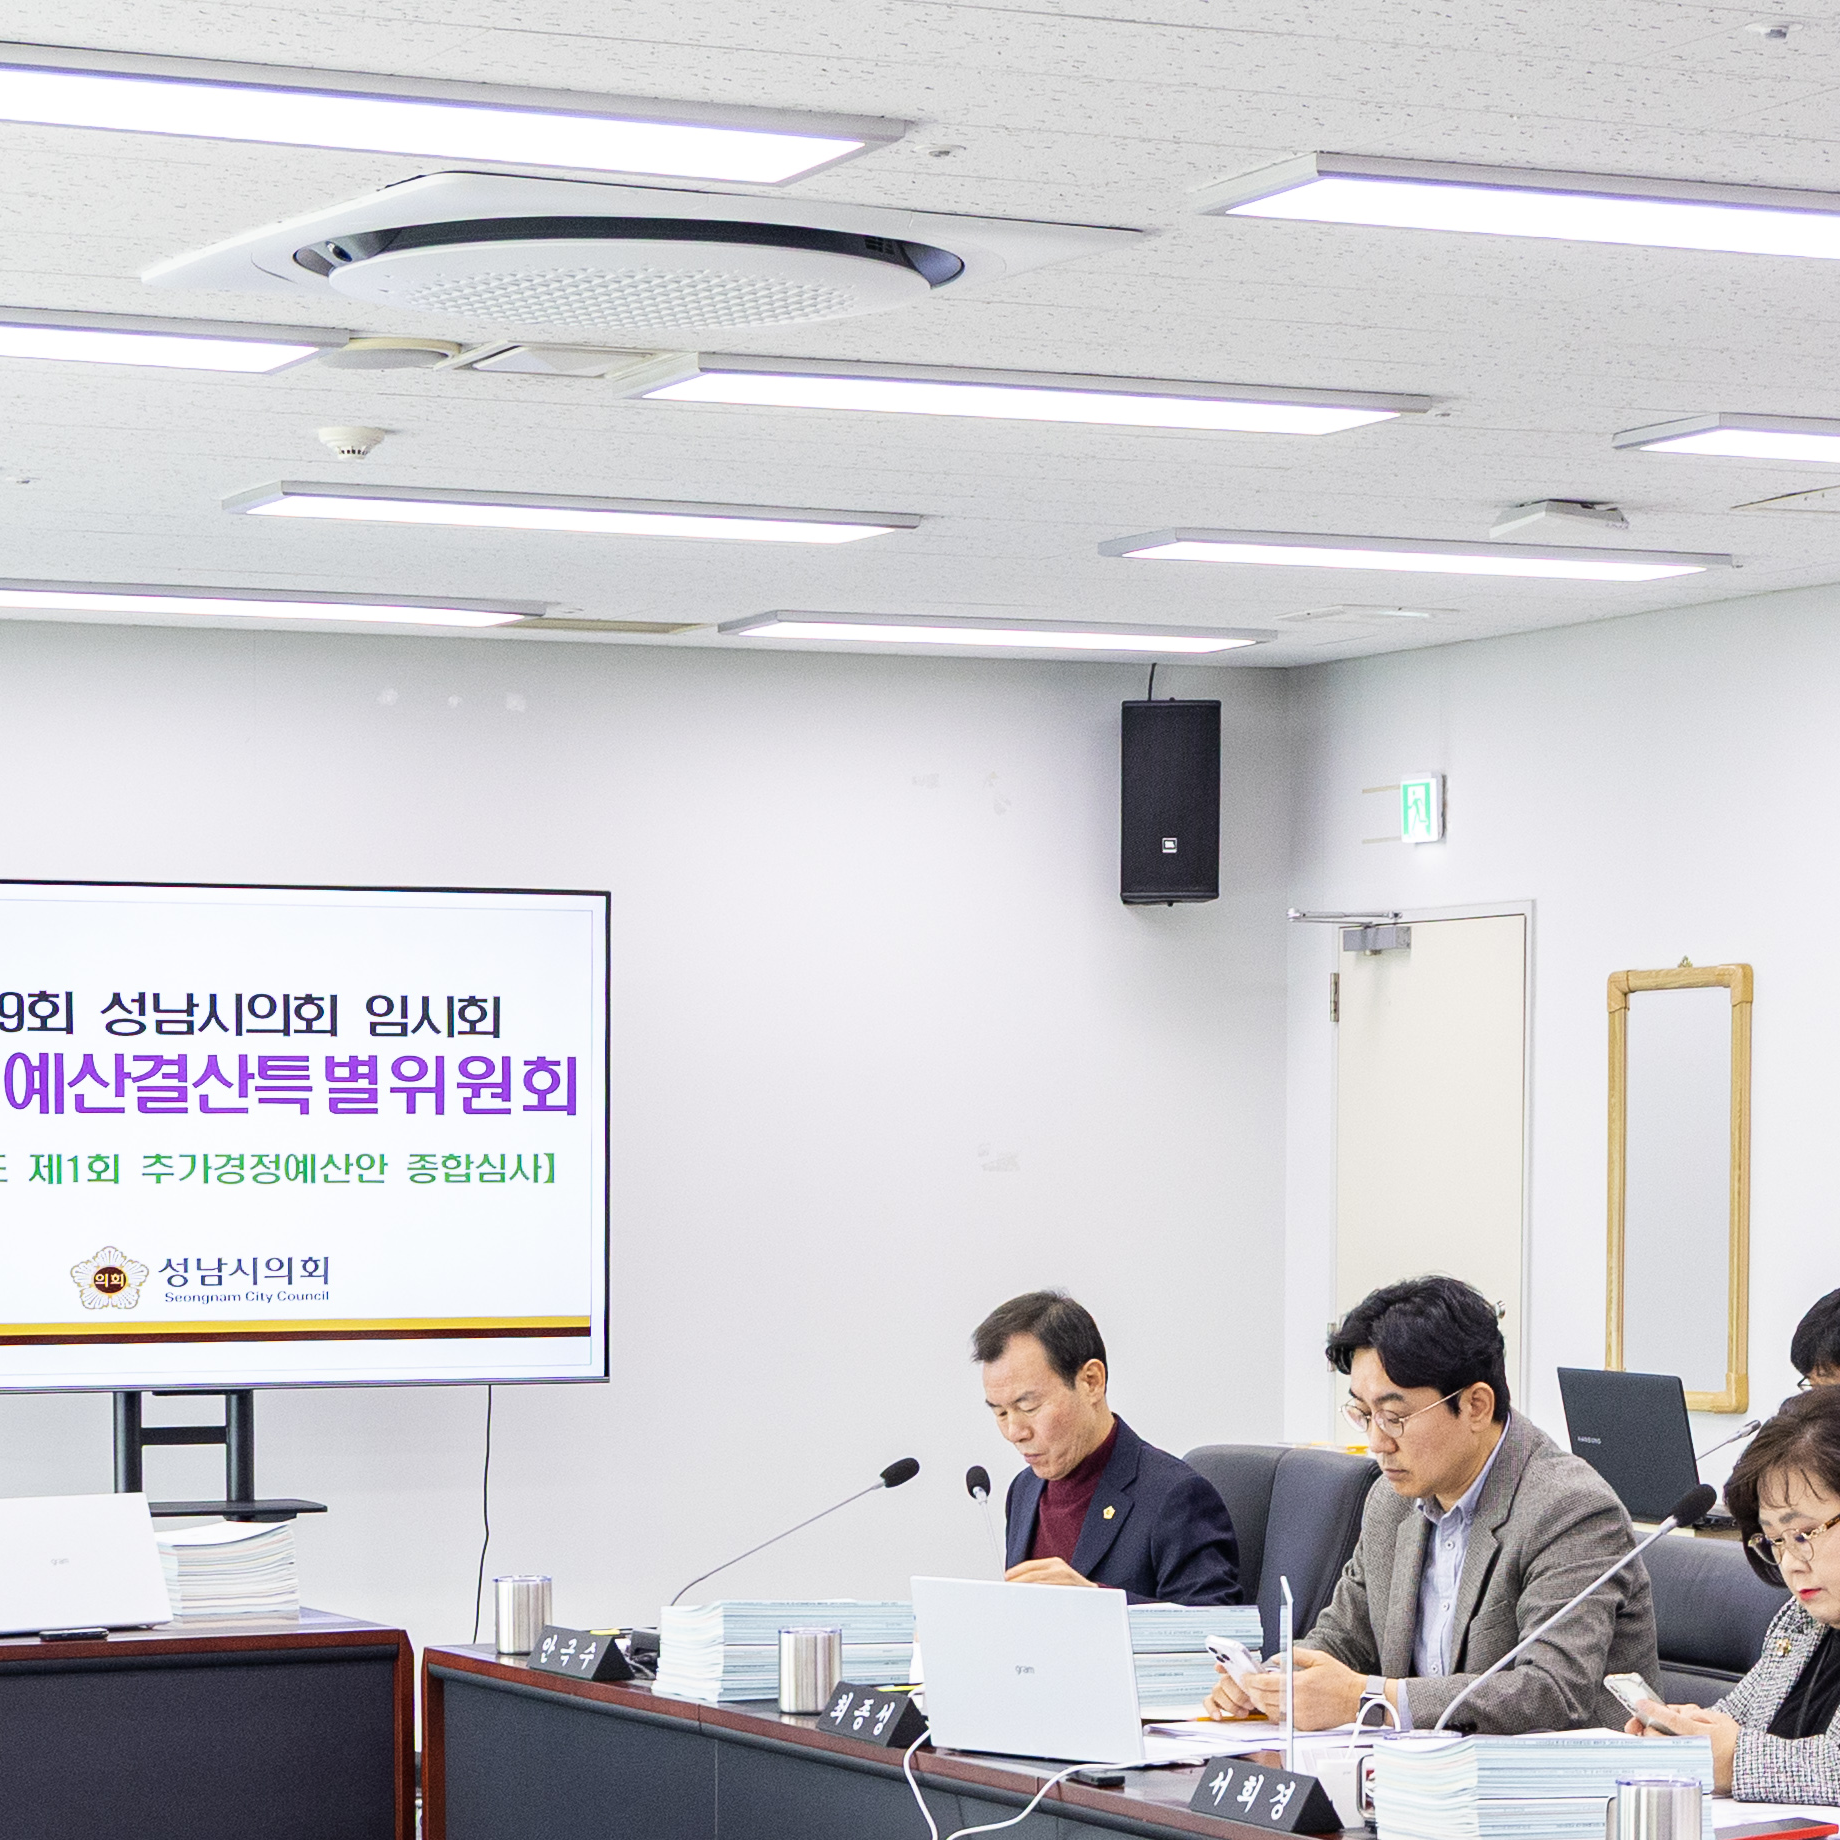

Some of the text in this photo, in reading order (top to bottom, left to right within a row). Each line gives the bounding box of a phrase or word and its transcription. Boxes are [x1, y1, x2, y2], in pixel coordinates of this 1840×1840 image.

[100, 990, 338, 1038] 성남시의회
[365, 993, 501, 1039] 임시회
[3, 1051, 577, 1117] 예산결산특별위원회
[28, 1153, 120, 1185] 제1회
[141, 1153, 389, 1185] 추가경정예산안
[158, 1256, 329, 1288] 성남시의회
[164, 1290, 329, 1304] Seongnam City Council
[1015, 1664, 1035, 1675] gram
[830, 1691, 896, 1736] 최종성
[1208, 1767, 1297, 1821] 서희경
